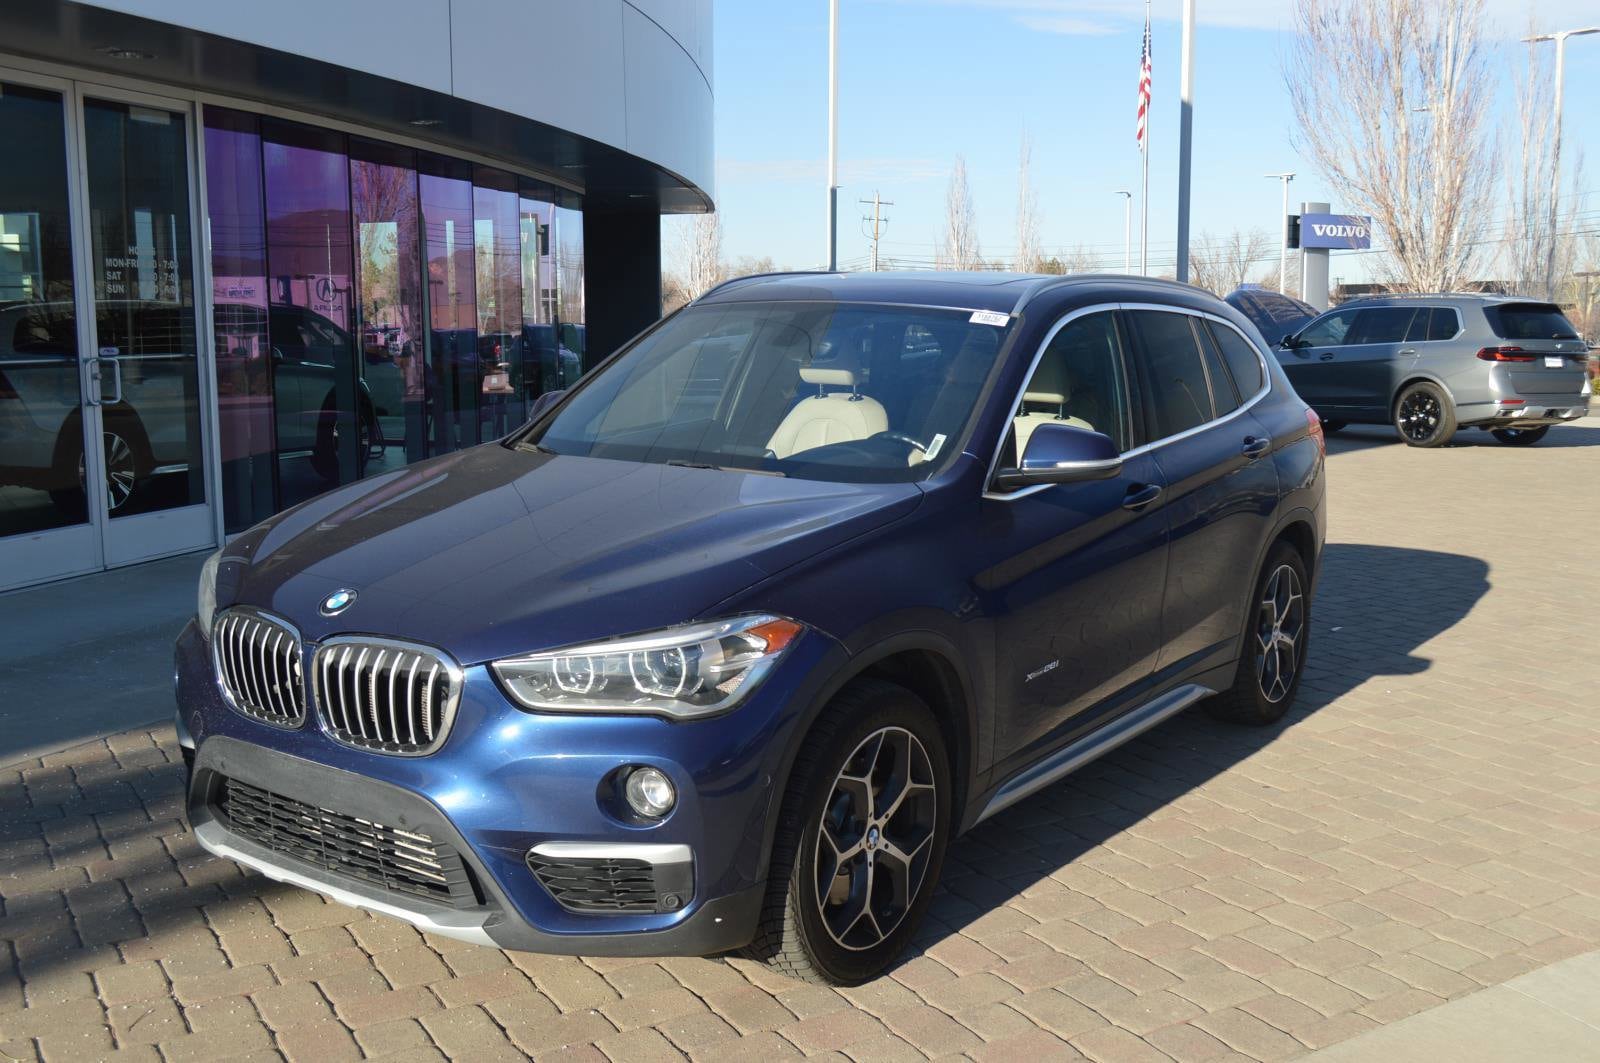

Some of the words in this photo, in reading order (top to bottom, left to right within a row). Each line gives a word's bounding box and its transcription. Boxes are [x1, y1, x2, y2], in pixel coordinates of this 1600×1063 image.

[1312, 224, 1365, 238] VOLVO
[106, 271, 121, 280] SAT
[106, 284, 125, 294] SUN
